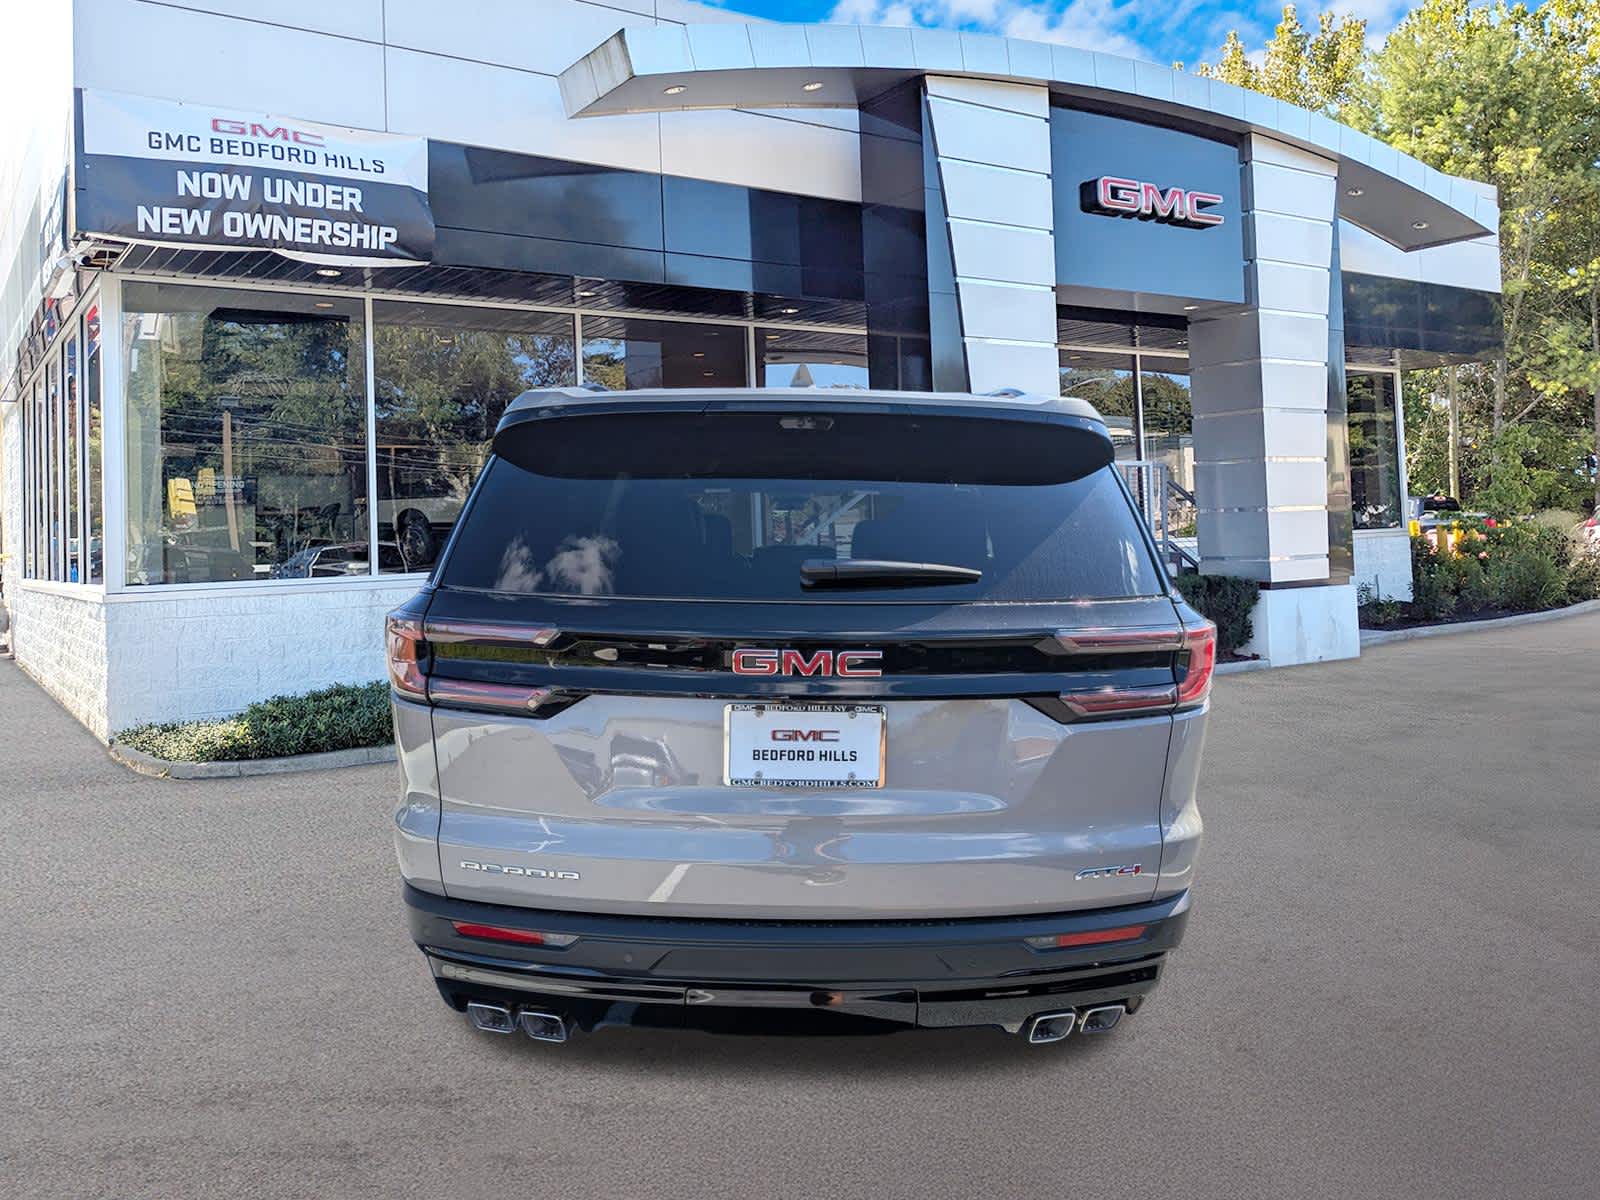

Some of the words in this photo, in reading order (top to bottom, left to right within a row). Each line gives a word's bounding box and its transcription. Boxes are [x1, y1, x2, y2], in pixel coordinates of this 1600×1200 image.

[211, 118, 325, 148] GMC
[148, 131, 201, 152] GMC
[210, 138, 316, 165] BEDFORD
[324, 153, 385, 174] HILLS
[176, 170, 252, 201] NOW
[263, 177, 363, 213] UNDER
[1097, 175, 1225, 225] GMC
[136, 205, 211, 236] NEW
[223, 211, 398, 250] OWNERSHIP
[732, 648, 883, 677] GMC
[765, 704, 806, 712] BEDFORD
[771, 729, 840, 742] GMC
[752, 749, 815, 762] BEDFORD
[819, 750, 858, 762] HILLS
[460, 860, 581, 880] ACADIA
[1073, 863, 1142, 881] AT4
